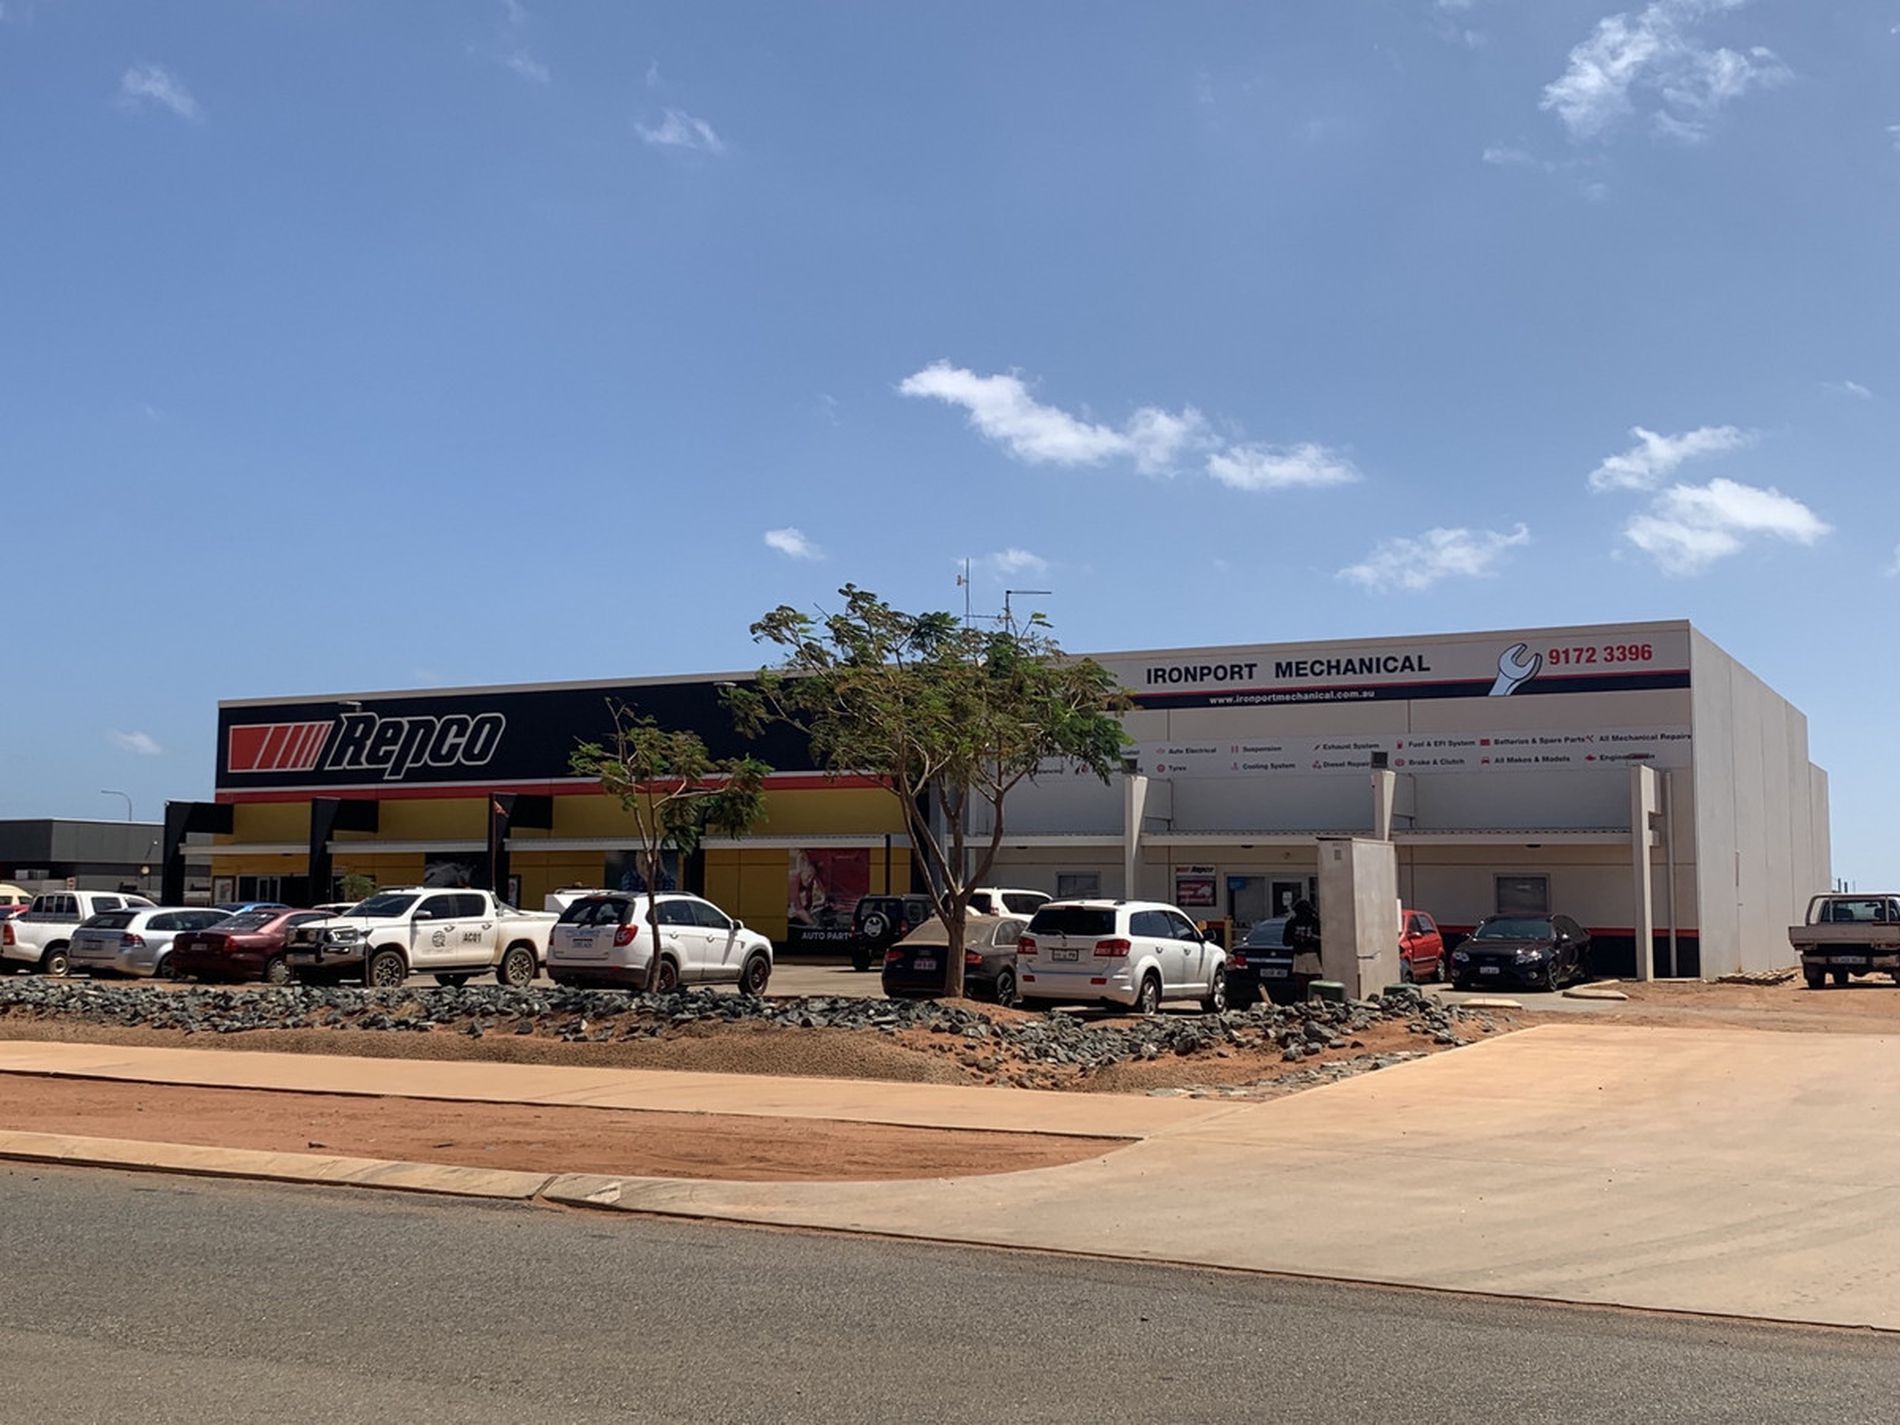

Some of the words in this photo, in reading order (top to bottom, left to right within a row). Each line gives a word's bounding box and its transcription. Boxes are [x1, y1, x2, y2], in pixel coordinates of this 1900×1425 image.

[1549, 647, 1597, 665] 9172
[1603, 644, 1653, 662] 3396
[1146, 663, 1258, 685] IRONPORT
[1274, 655, 1431, 679] MECHANICAL
[1209, 689, 1375, 704] www.ironportmechanical.com.au
[1493, 738, 1529, 746] Batteries
[1539, 737, 1563, 746] Spare
[1564, 736, 1585, 744] Parts
[1611, 734, 1659, 743] Mechanical
[1659, 732, 1692, 742] Repairs
[324, 712, 506, 779] Repco
[1322, 743, 1352, 751] Exhaust
[1353, 742, 1380, 752] System
[1408, 741, 1425, 749] Fuel
[1426, 740, 1433, 748] &
[1448, 739, 1476, 749] System
[1168, 747, 1186, 755] Auto
[1187, 746, 1217, 754] Electrical
[1242, 746, 1283, 755] Suspension
[1322, 760, 1346, 769] Diesel
[1408, 759, 1431, 767] Brake
[1440, 757, 1465, 766] Clutch
[1507, 756, 1533, 764] Makes
[1534, 755, 1540, 763] &
[1541, 755, 1571, 763] Models
[1168, 764, 1187, 772] Tyres
[1242, 762, 1268, 771] Cooling
[1269, 761, 1296, 771] System
[801, 931, 825, 941] AUTO
